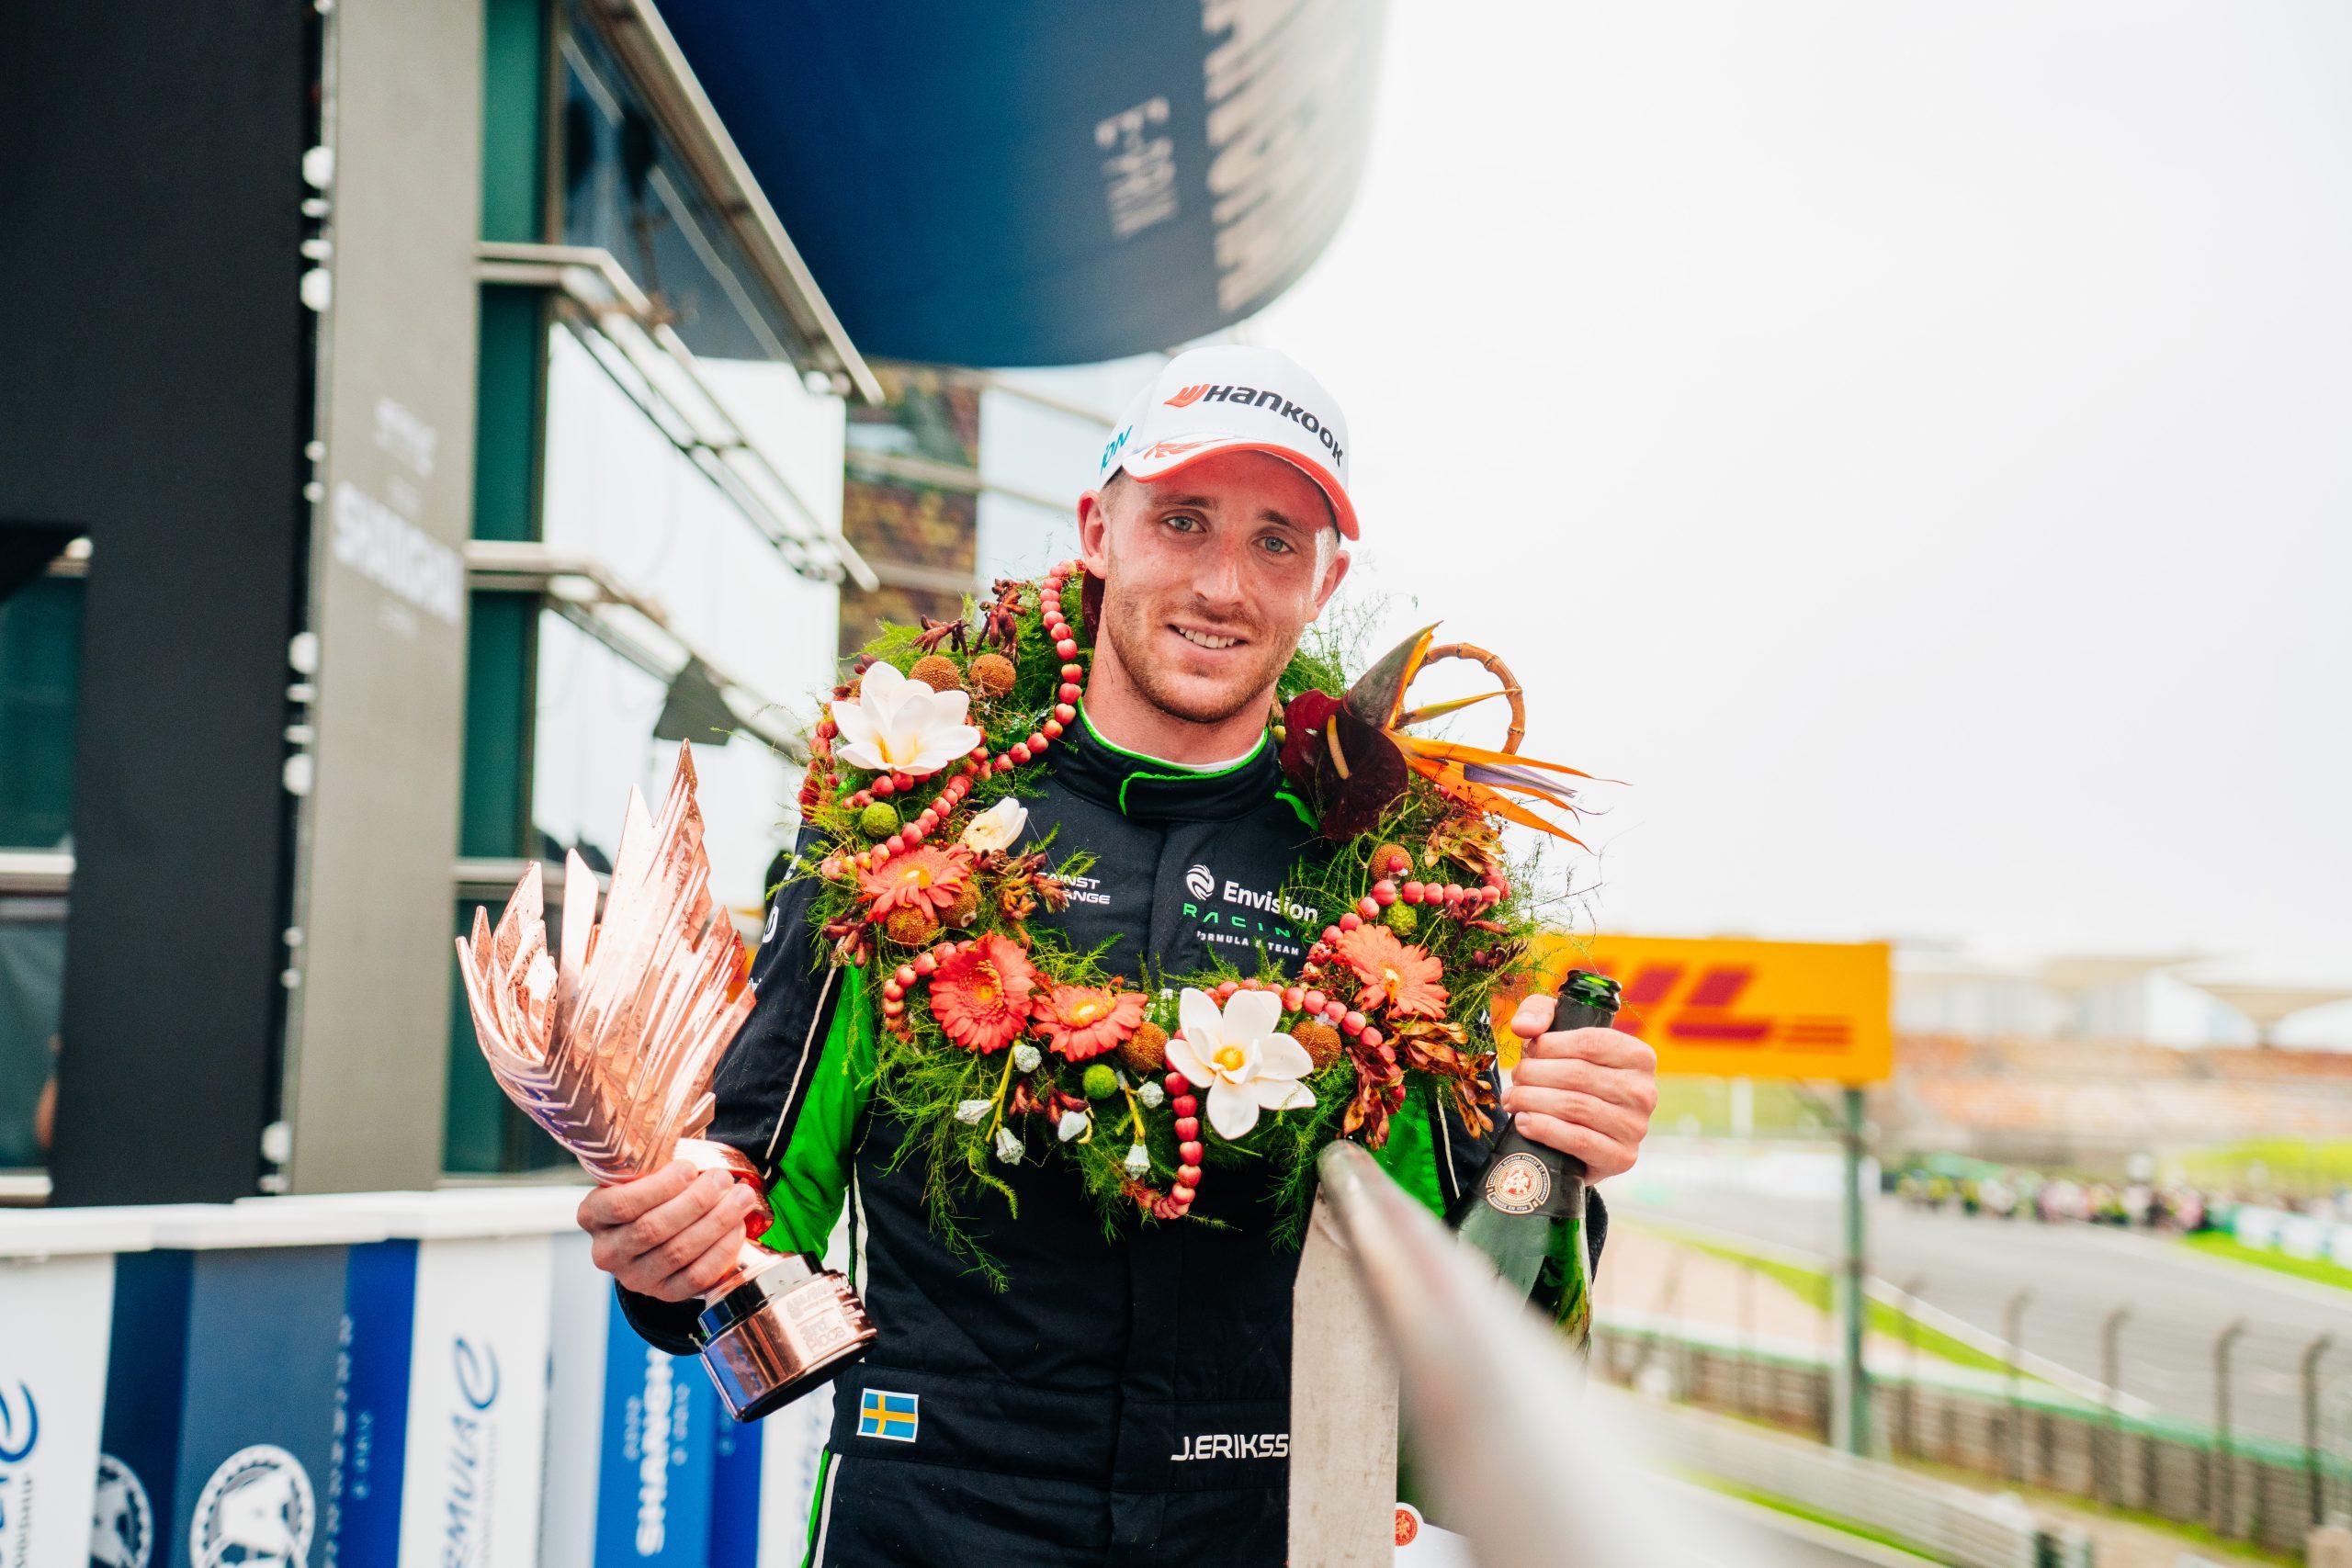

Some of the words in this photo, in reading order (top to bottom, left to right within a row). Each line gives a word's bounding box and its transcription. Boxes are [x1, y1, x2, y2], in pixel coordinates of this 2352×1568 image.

[1223, 880, 1318, 924] Envision
[1196, 931, 1250, 947] FORMULA
[1267, 942, 1300, 956] TEAM
[1170, 1433, 1291, 1461] J.ERIKSS
